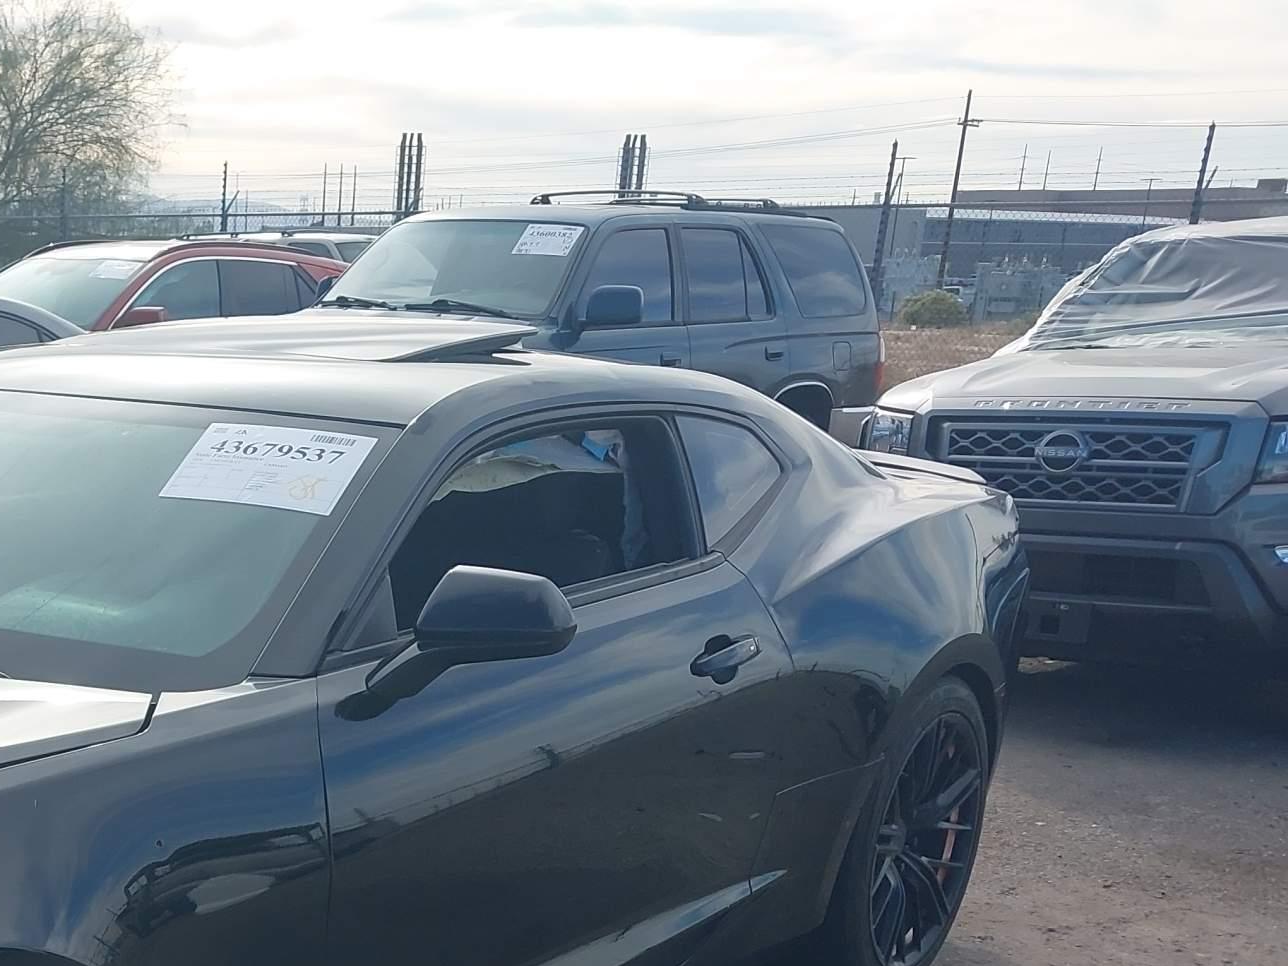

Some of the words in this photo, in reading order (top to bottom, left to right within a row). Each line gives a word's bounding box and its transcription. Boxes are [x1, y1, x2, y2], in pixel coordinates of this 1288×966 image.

[973, 399, 1192, 411] FRONTIER
[210, 439, 347, 465] 43679537
[1034, 446, 1089, 458] NISSAN
